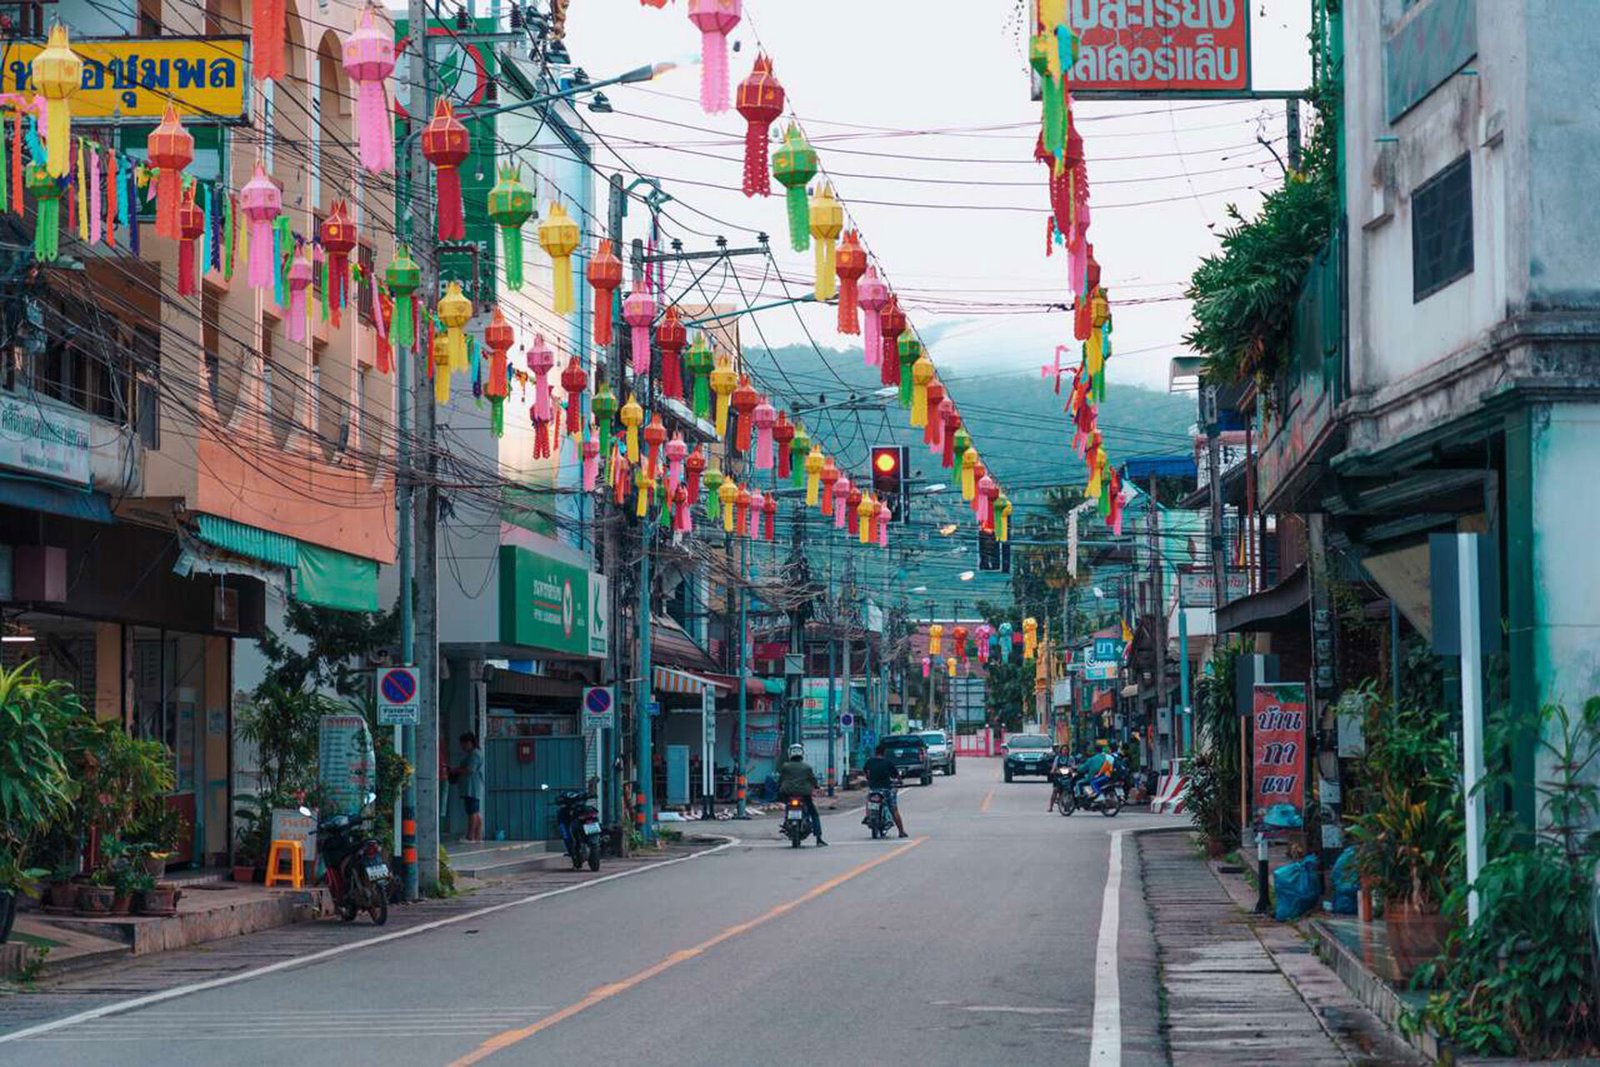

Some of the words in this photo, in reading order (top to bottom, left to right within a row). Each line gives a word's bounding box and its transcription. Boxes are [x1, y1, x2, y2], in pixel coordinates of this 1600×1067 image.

[9, 54, 237, 108] หอชุมพล
[1068, 34, 1239, 81] ลเลอร์แล็บ
[1259, 706, 1302, 732] บ้าน
